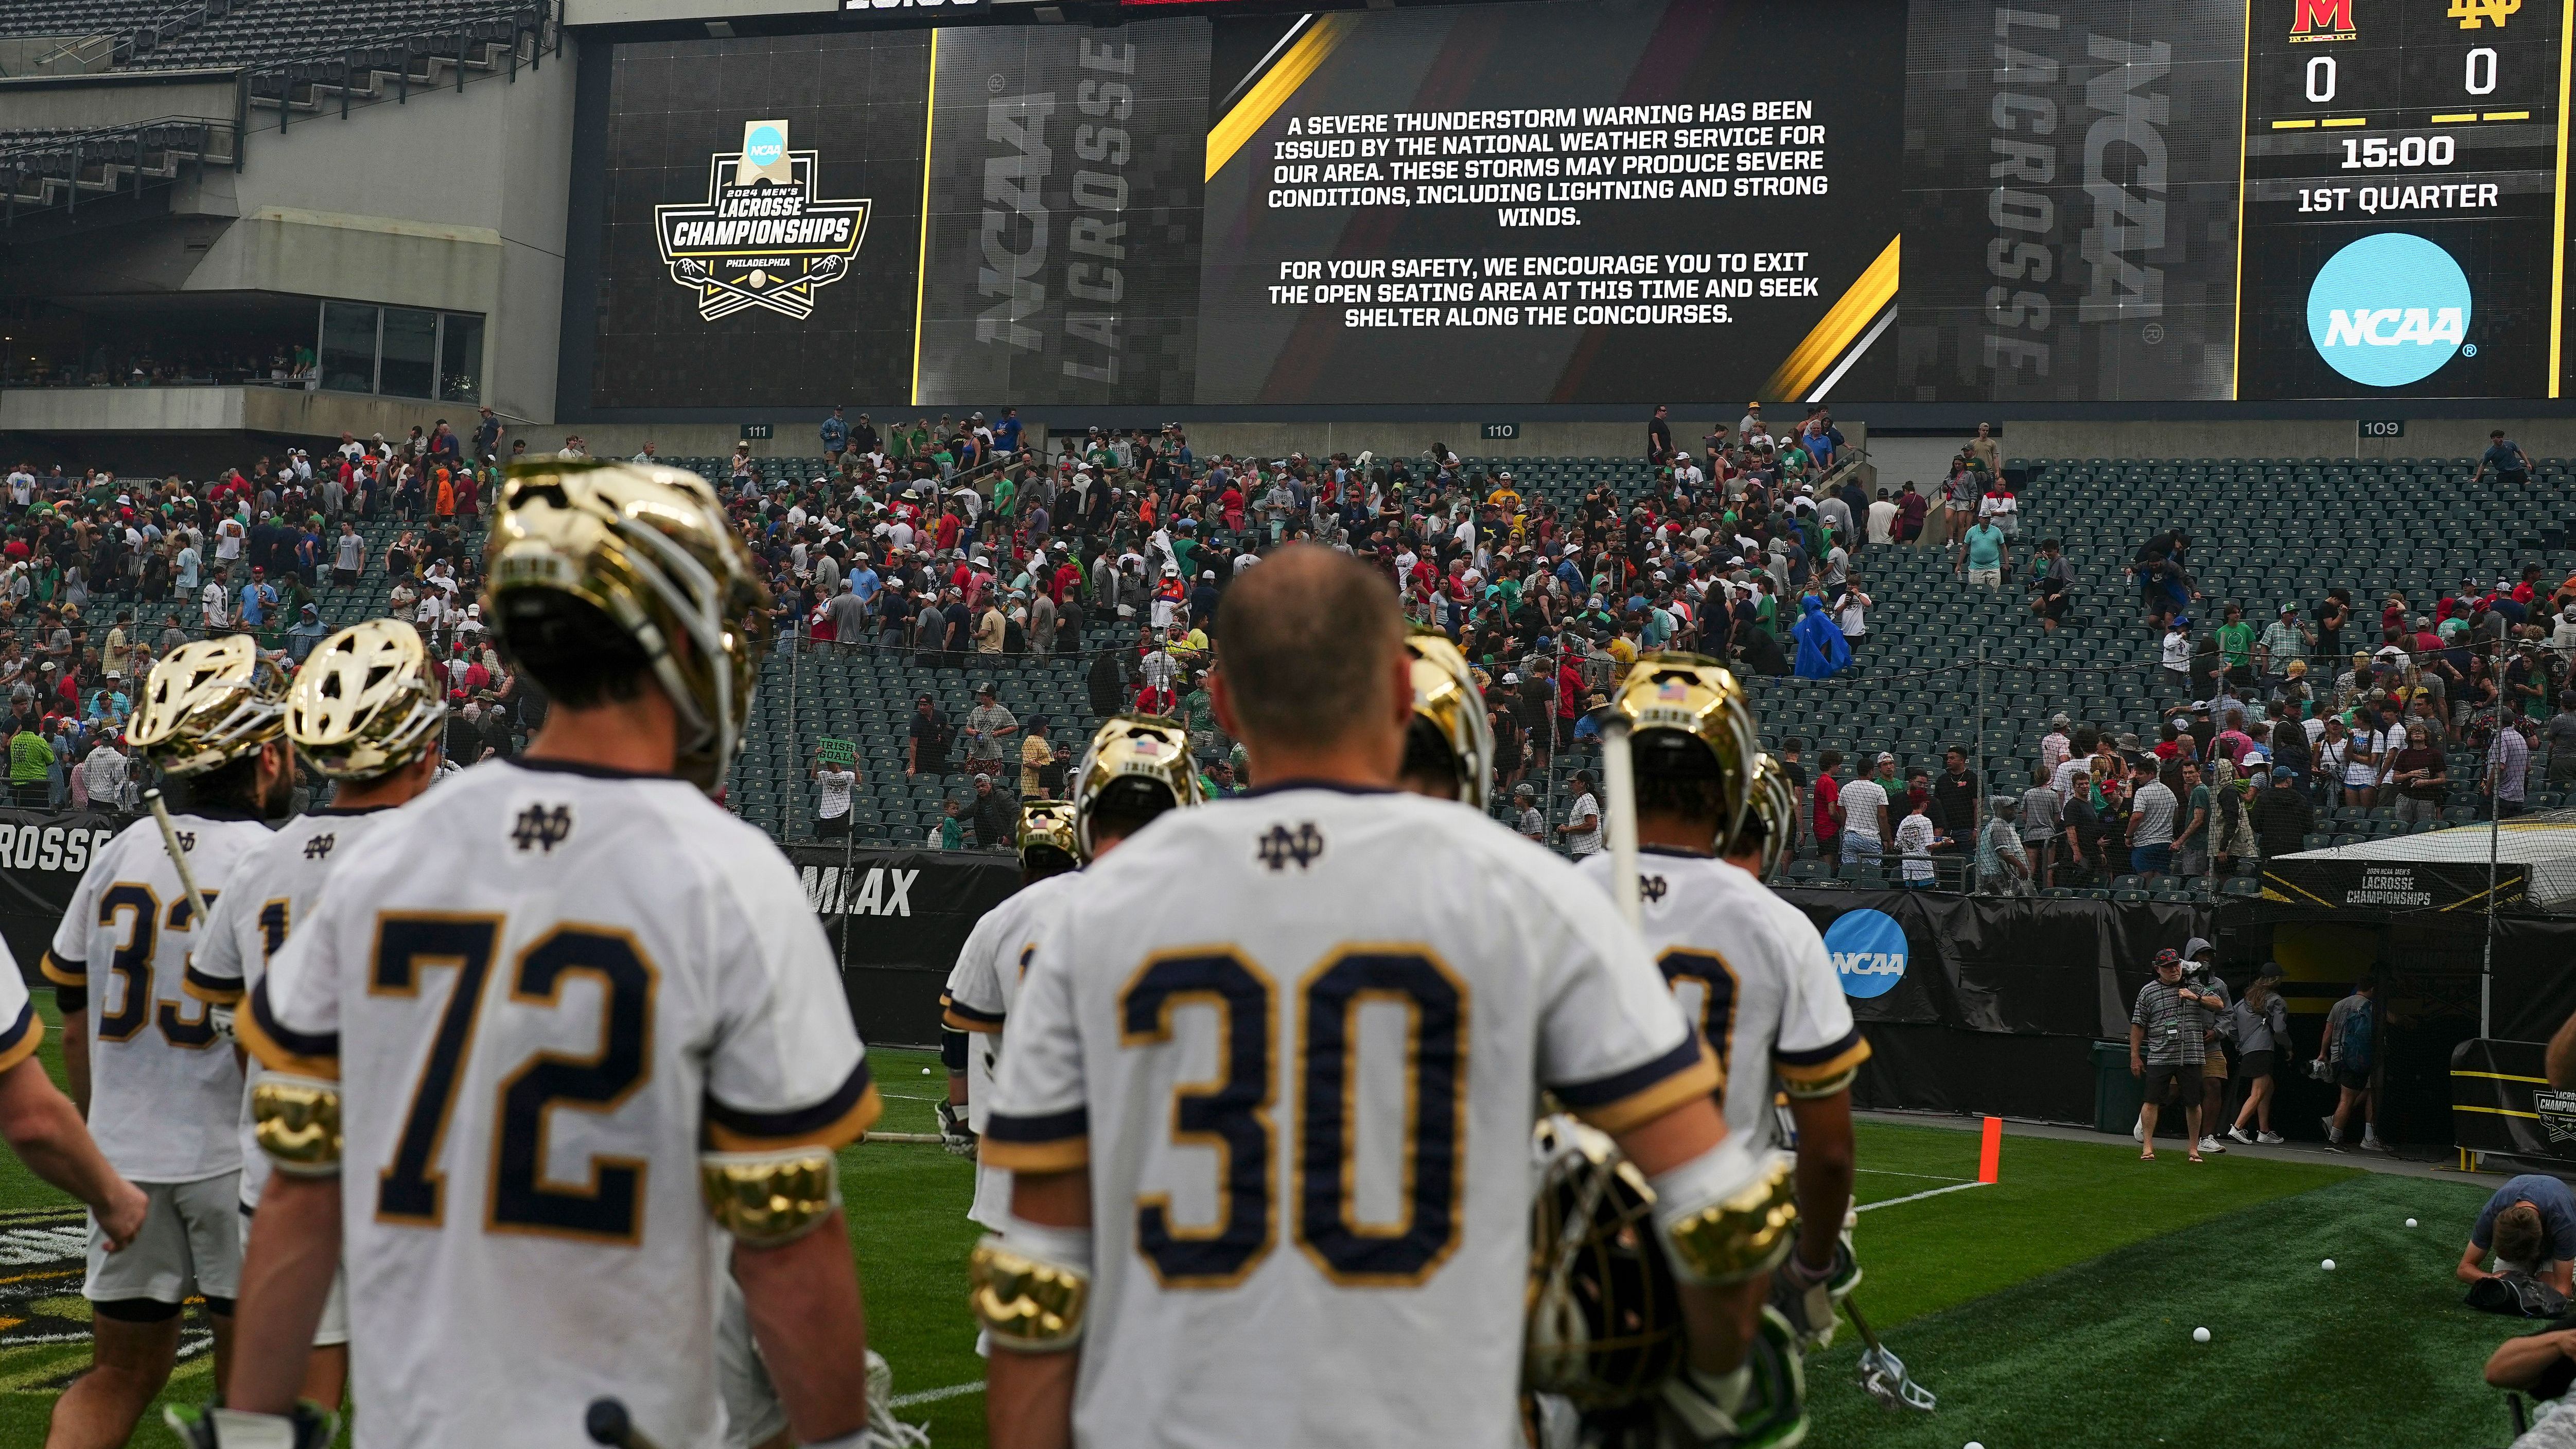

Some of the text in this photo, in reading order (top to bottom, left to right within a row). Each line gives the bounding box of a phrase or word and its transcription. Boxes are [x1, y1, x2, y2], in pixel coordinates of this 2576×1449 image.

[2306, 57, 2336, 102] 0
[2465, 48, 2497, 95] 0
[1288, 100, 1811, 135] A SEVERE THUNDERSTORM WARNING HAS BEEN
[750, 144, 782, 156] NCAA
[1274, 126, 1825, 159] ISSUED BY THE NATIONAL WEATHER SERVICE FOR
[2341, 135, 2455, 168] 15:00
[1274, 151, 1823, 183] OUR AREA. THESE STORMS MAY PRODUCE SEVERE
[2079, 33, 2171, 323] NCAA
[726, 187, 798, 197] 2024 MEN'S
[1269, 176, 1827, 207] CONDITIONS, INCLUDING LIGHTNING AND STRONG
[1984, 7, 2060, 376] LACROSSE
[2298, 183, 2498, 215] 1ST QUARTER
[718, 197, 804, 218] LACROSSE
[975, 91, 1055, 352] NCAA
[1063, 38, 1135, 385] LACROSSE
[1498, 207, 1580, 226] WINDS.
[673, 218, 851, 247] CHAMPIONSHIPS
[726, 258, 790, 267] PHILADELPHIA
[1281, 253, 1808, 280] FOR YOUR SAFETY, WE ENCOURAGE YOU TO EXIT
[1269, 277, 1818, 304] THE OPEN SEATING AREA AT THIS TIME AND SEEK
[1345, 305, 1732, 327] SHELTER ALONG THE CONCOURSES.
[2323, 307, 2463, 346] NCAA
[748, 426, 766, 438] 111
[1487, 425, 1513, 437] 110
[2364, 422, 2399, 435] 109
[819, 750, 853, 763] GOAL!
[821, 740, 854, 753] IRISH
[2362, 876, 2414, 890] LACROSSE
[2346, 890, 2431, 905] CHAMPIONSHIPS
[1832, 952, 1904, 976] NCAA
[367, 909, 661, 1248] 72
[1116, 941, 1471, 1290] 30
